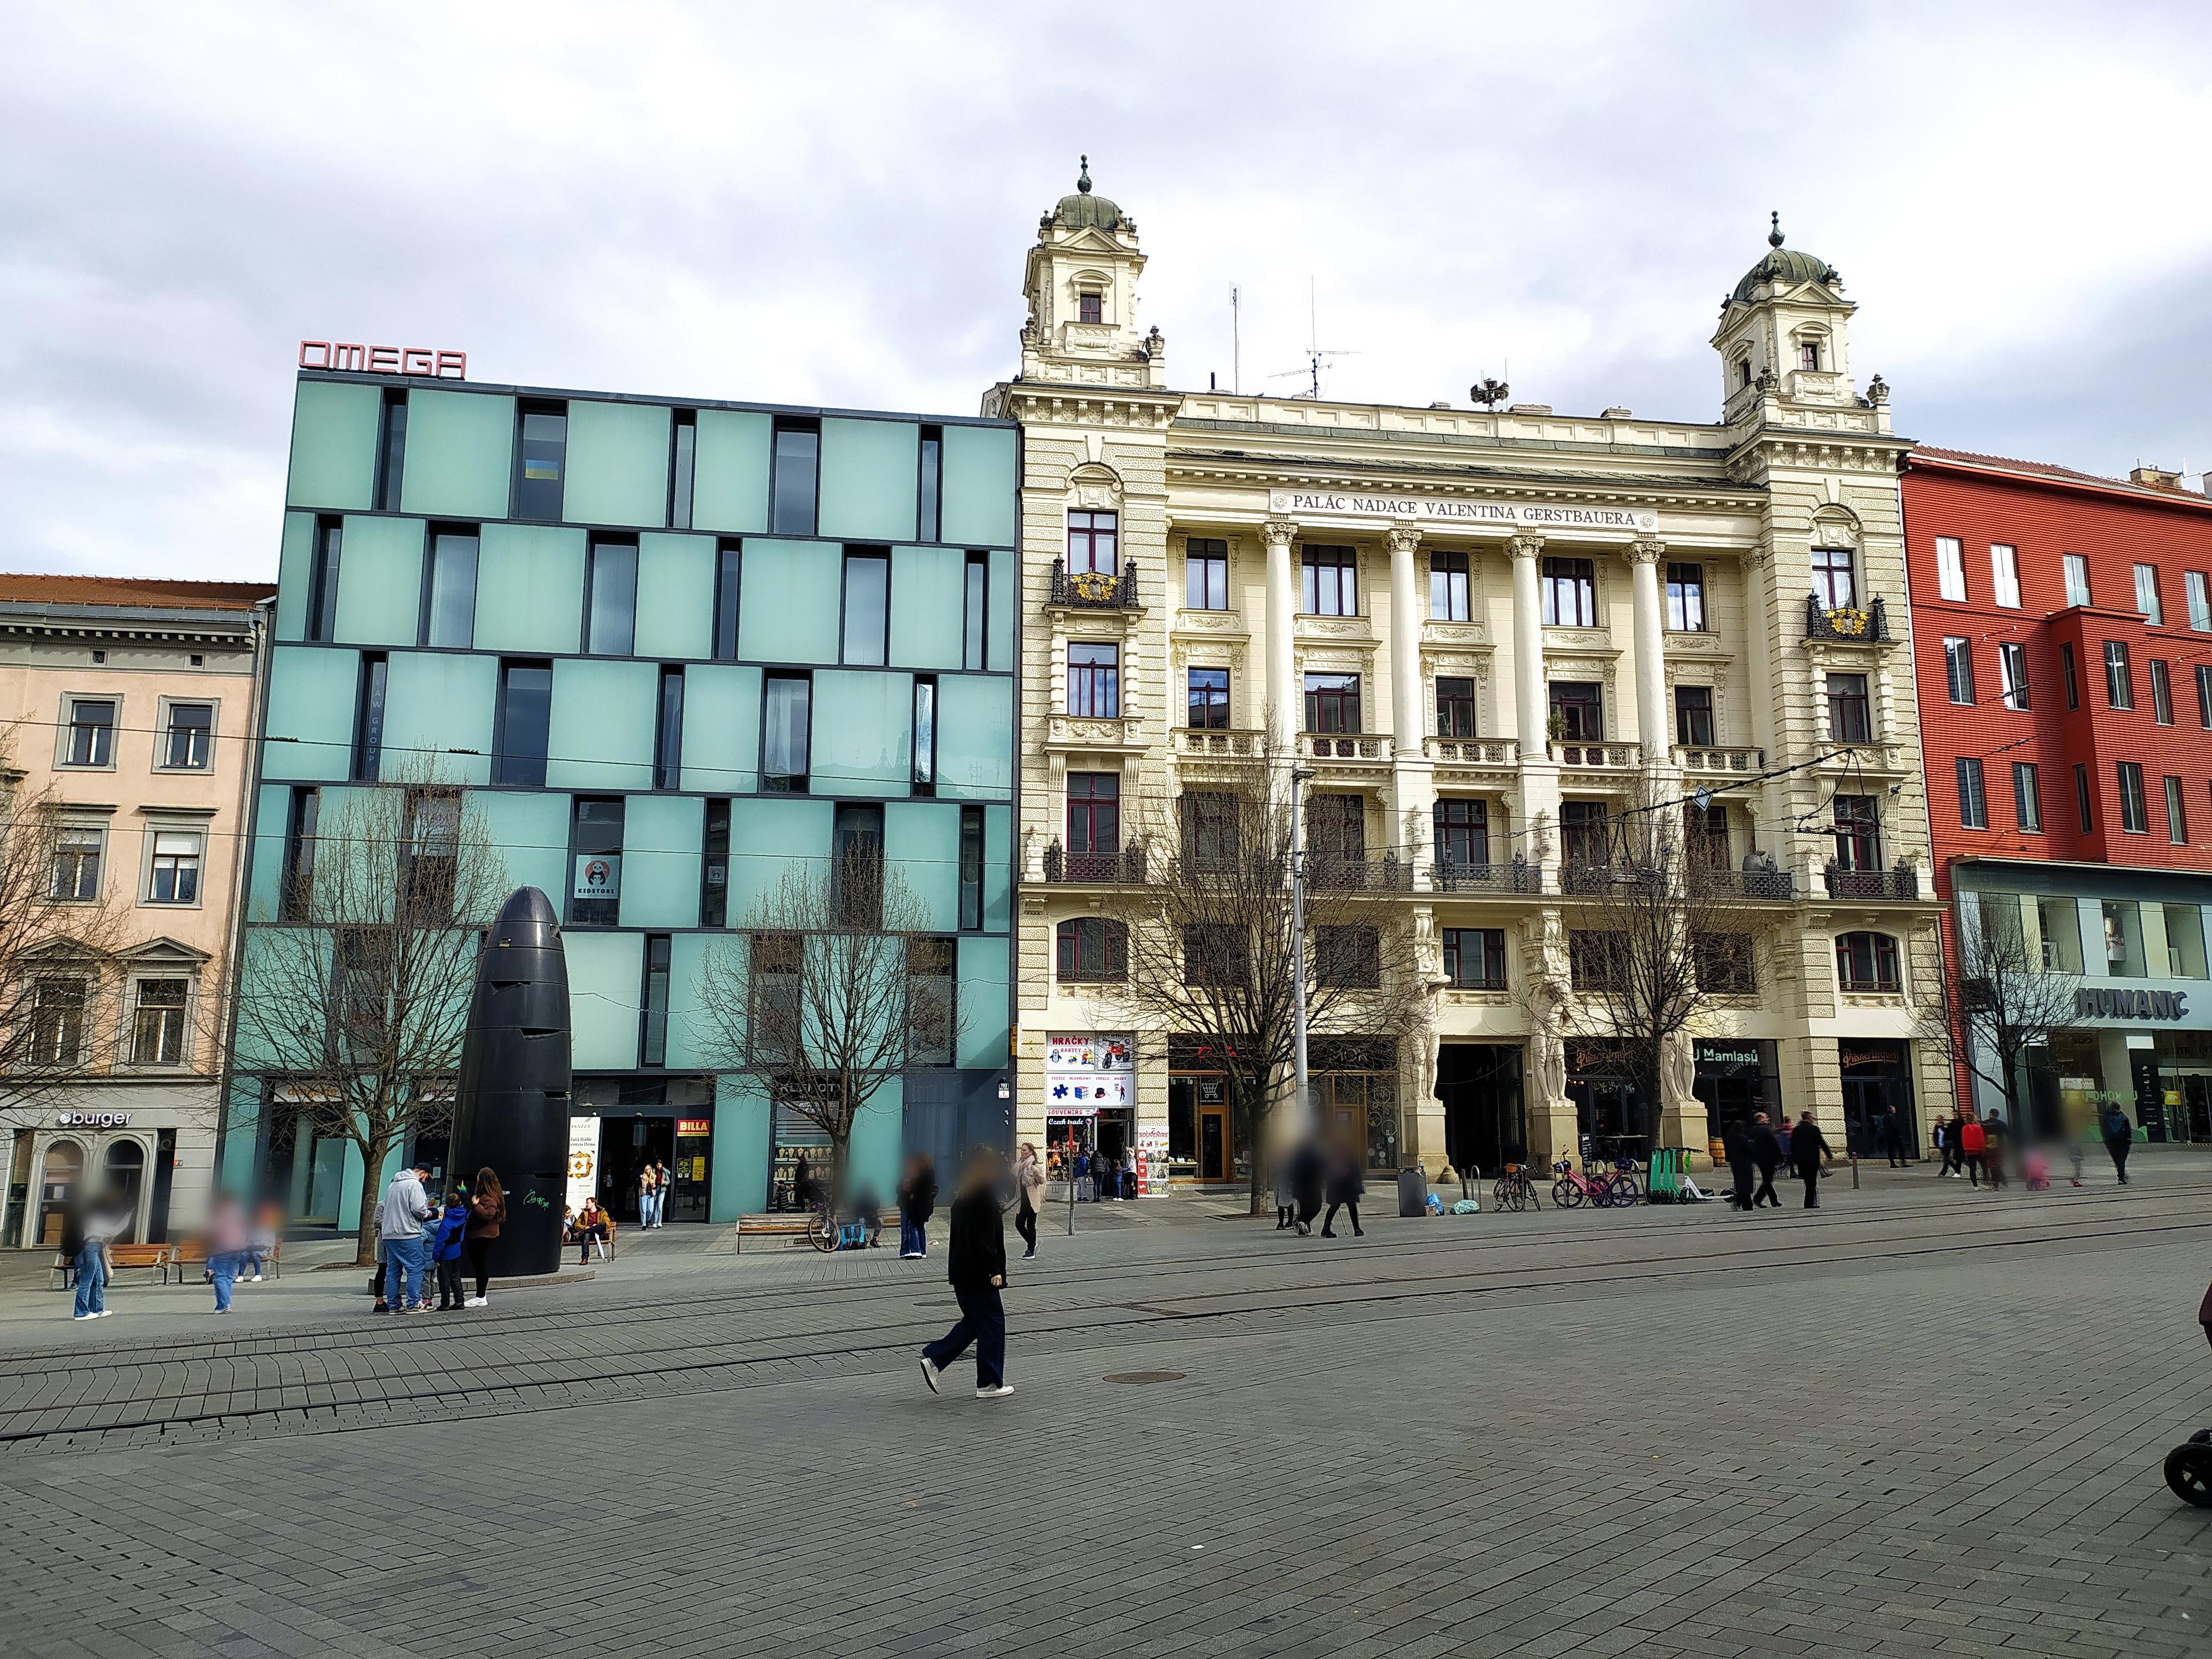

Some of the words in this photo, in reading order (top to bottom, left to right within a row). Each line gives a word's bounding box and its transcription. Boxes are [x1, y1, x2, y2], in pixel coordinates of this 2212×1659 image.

[299, 340, 466, 380] OMEGA
[1293, 494, 1345, 509] PALÁC
[1353, 498, 1417, 513] NADACE
[1425, 503, 1516, 519] VALENTINA
[1524, 508, 1636, 525] GERSTBAUERA
[369, 717, 378, 762] GROUP
[2076, 988, 2189, 1021] HUMANIC
[1052, 1035, 1089, 1045] HRAČKY
[1704, 1048, 1758, 1061] Mamlasů
[680, 1121, 708, 1131] BILLA
